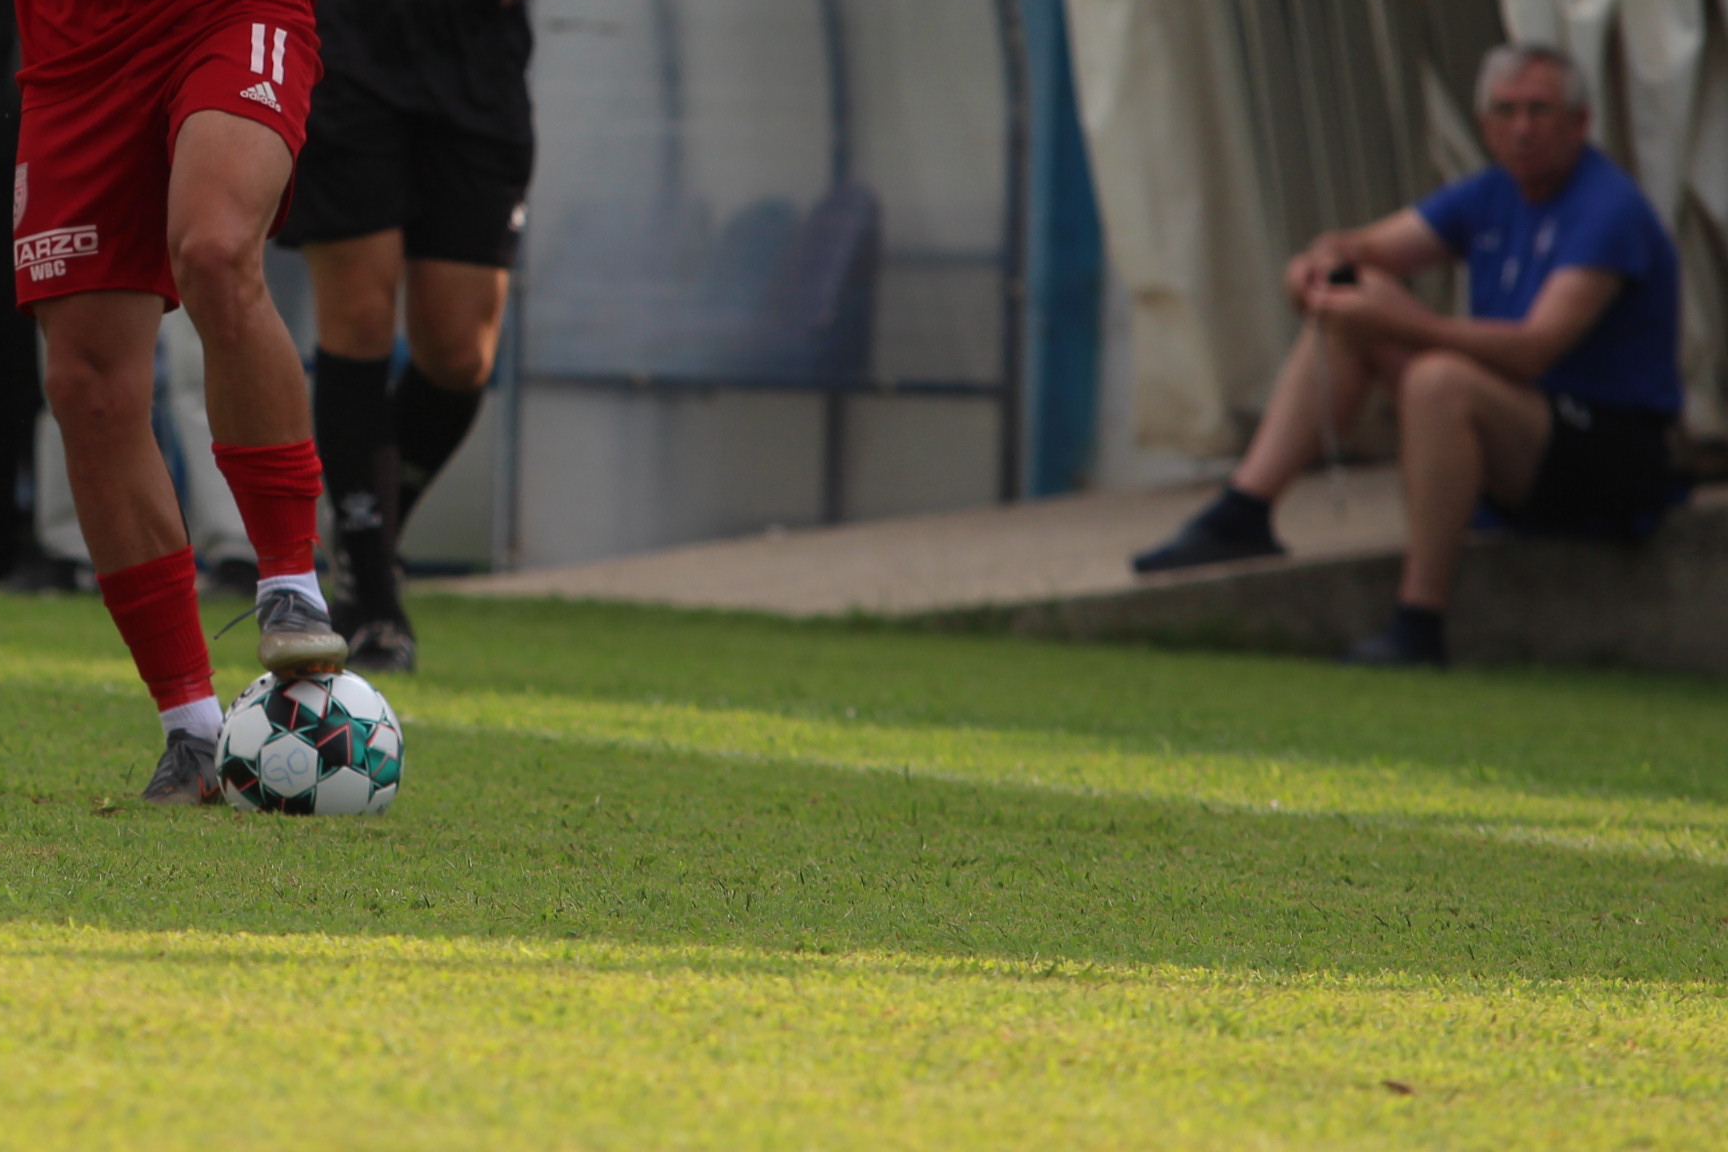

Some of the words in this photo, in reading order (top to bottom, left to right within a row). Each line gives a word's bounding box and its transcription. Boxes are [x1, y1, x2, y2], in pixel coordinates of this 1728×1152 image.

[249, 22, 288, 86] 11
[239, 89, 282, 113] adidas
[29, 259, 67, 282] WBC
